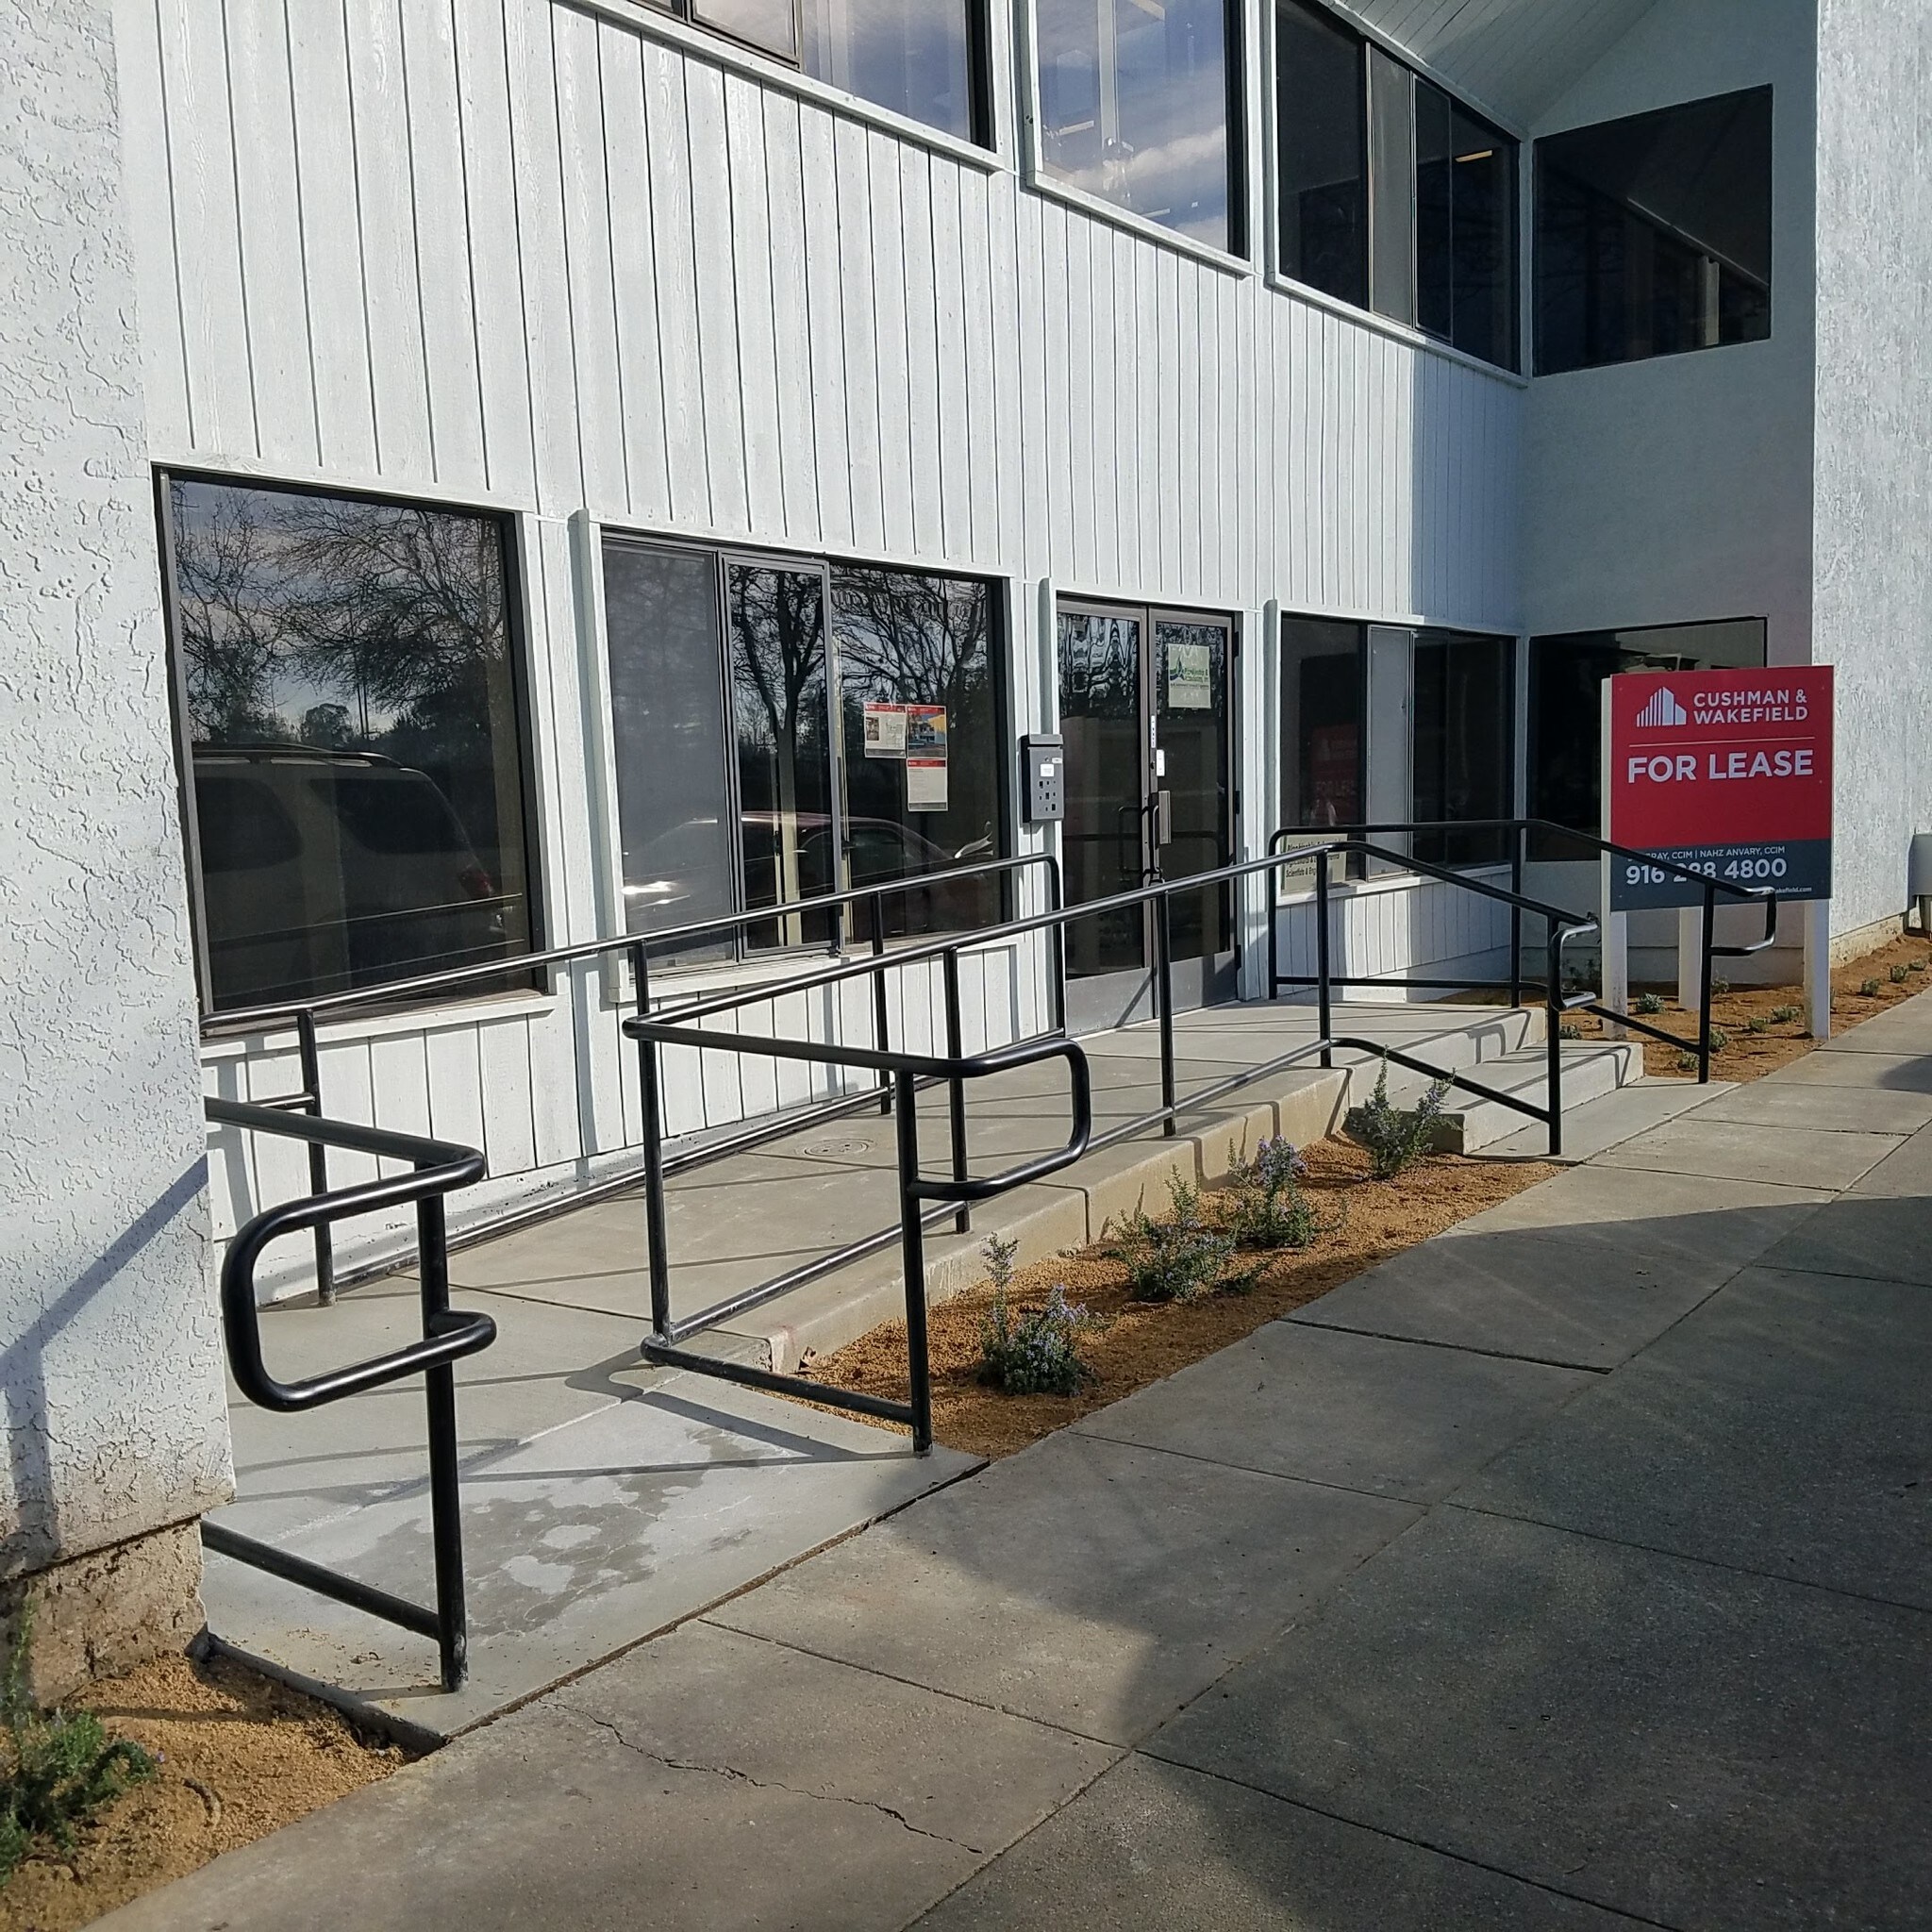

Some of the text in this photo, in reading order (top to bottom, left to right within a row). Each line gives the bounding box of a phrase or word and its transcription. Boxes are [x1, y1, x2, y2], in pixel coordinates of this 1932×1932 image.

[1693, 689, 1807, 707] CUSHMAN &
[1693, 707, 1808, 724] WAKEFIELD
[1628, 749, 1813, 783] FOR LEASE
[1645, 852, 1670, 860] RAY,
[1672, 851, 1693, 859] CCIM
[1700, 849, 1724, 858] NAHZ
[1725, 848, 1763, 857] ANVARY,
[1764, 846, 1786, 855] CCIM
[1626, 864, 1665, 885] 916
[1724, 858, 1788, 879] 4800
